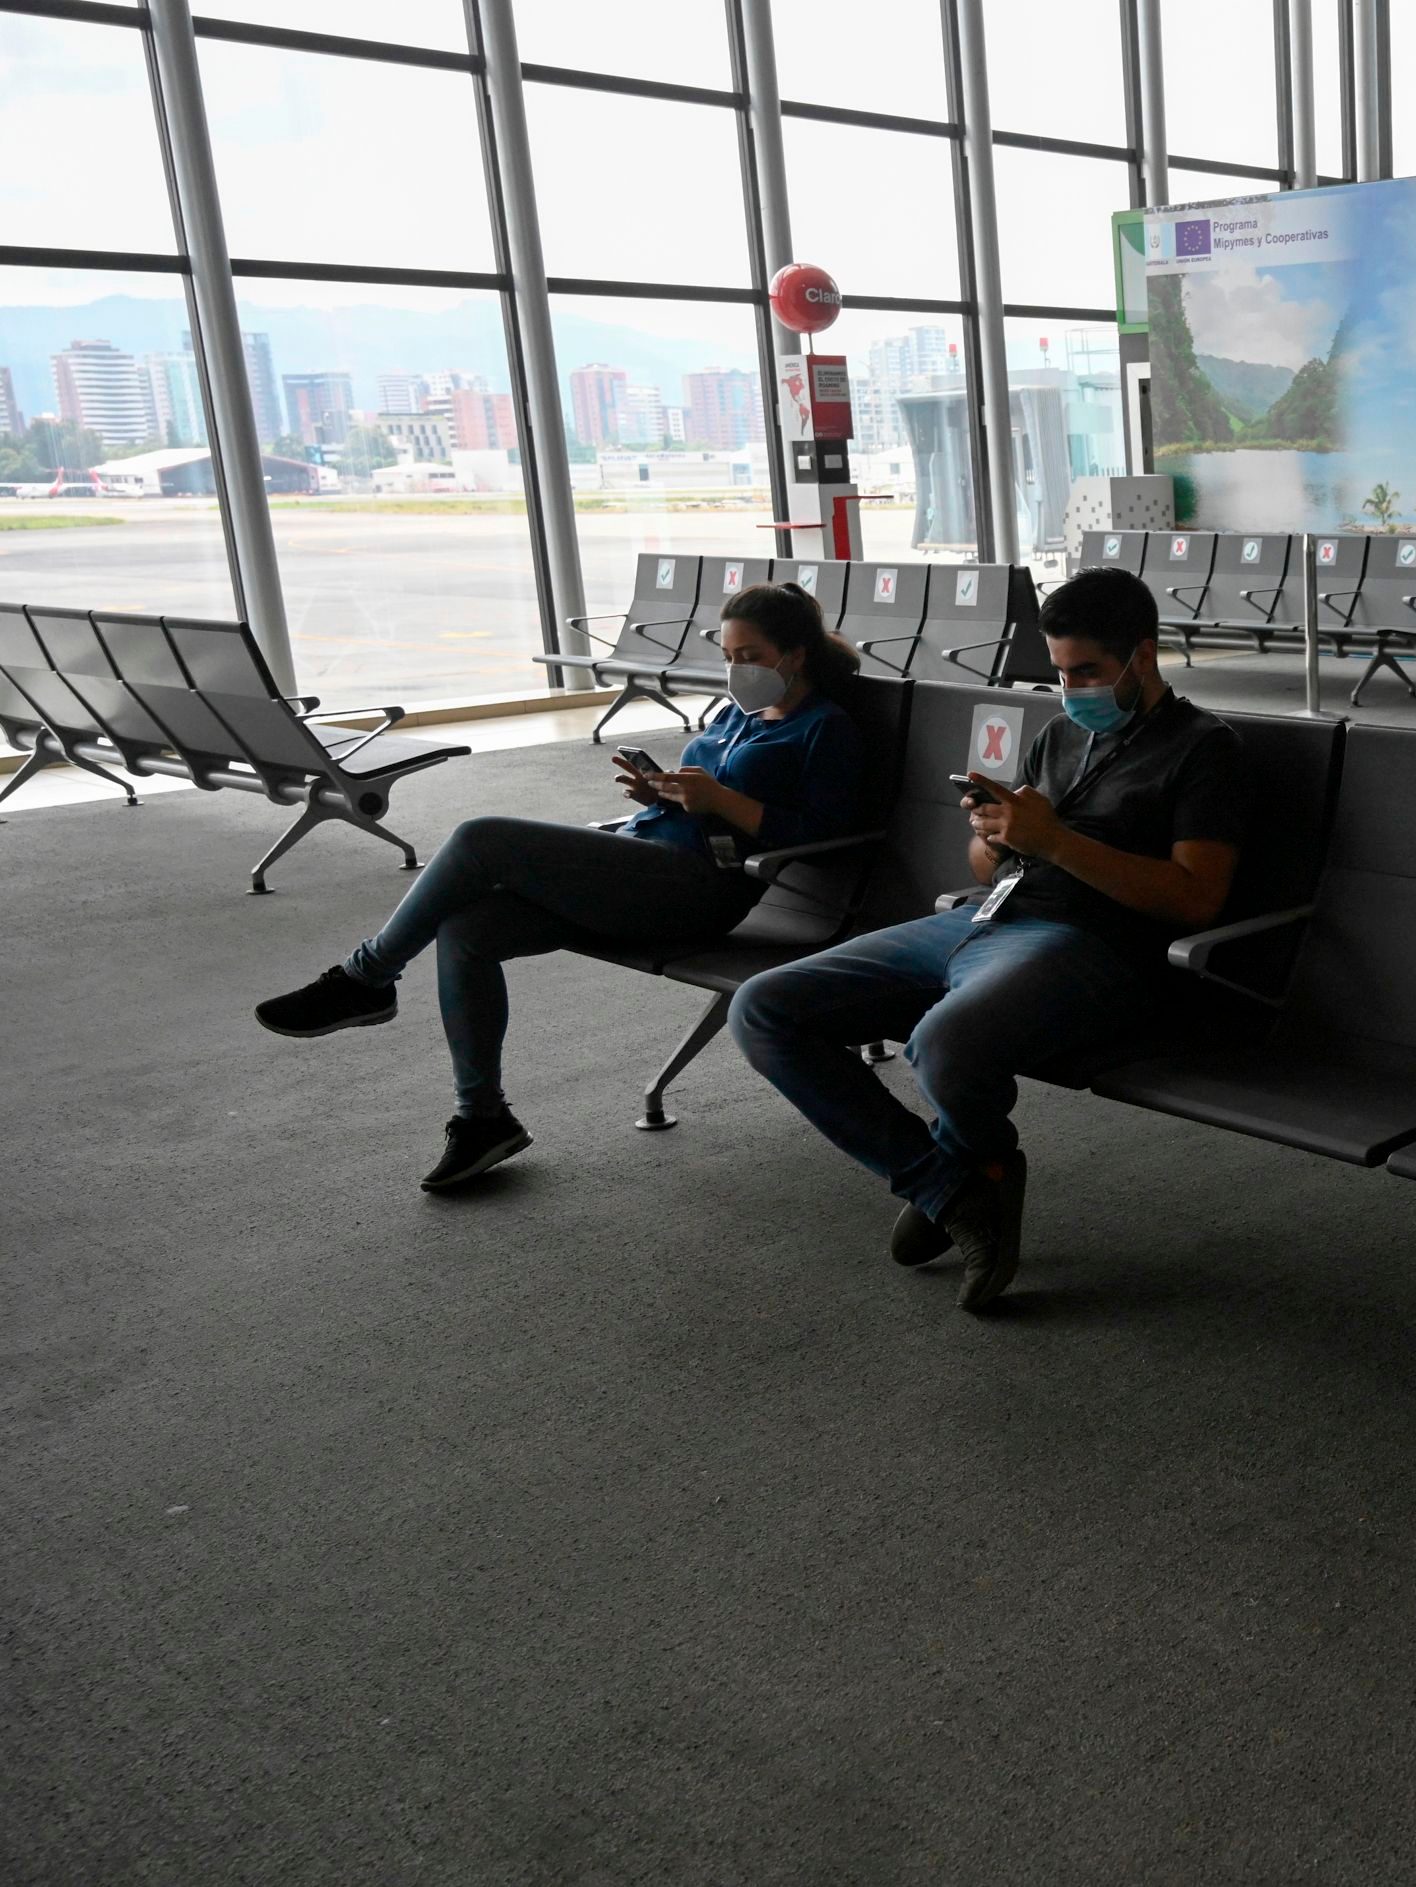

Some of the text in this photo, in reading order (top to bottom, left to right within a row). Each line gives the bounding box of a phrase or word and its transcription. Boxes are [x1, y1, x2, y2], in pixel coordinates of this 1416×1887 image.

[1213, 219, 1258, 233] Programa
[1213, 228, 1329, 250] Mipymes y Cooperativas
[805, 287, 841, 304] Claro
